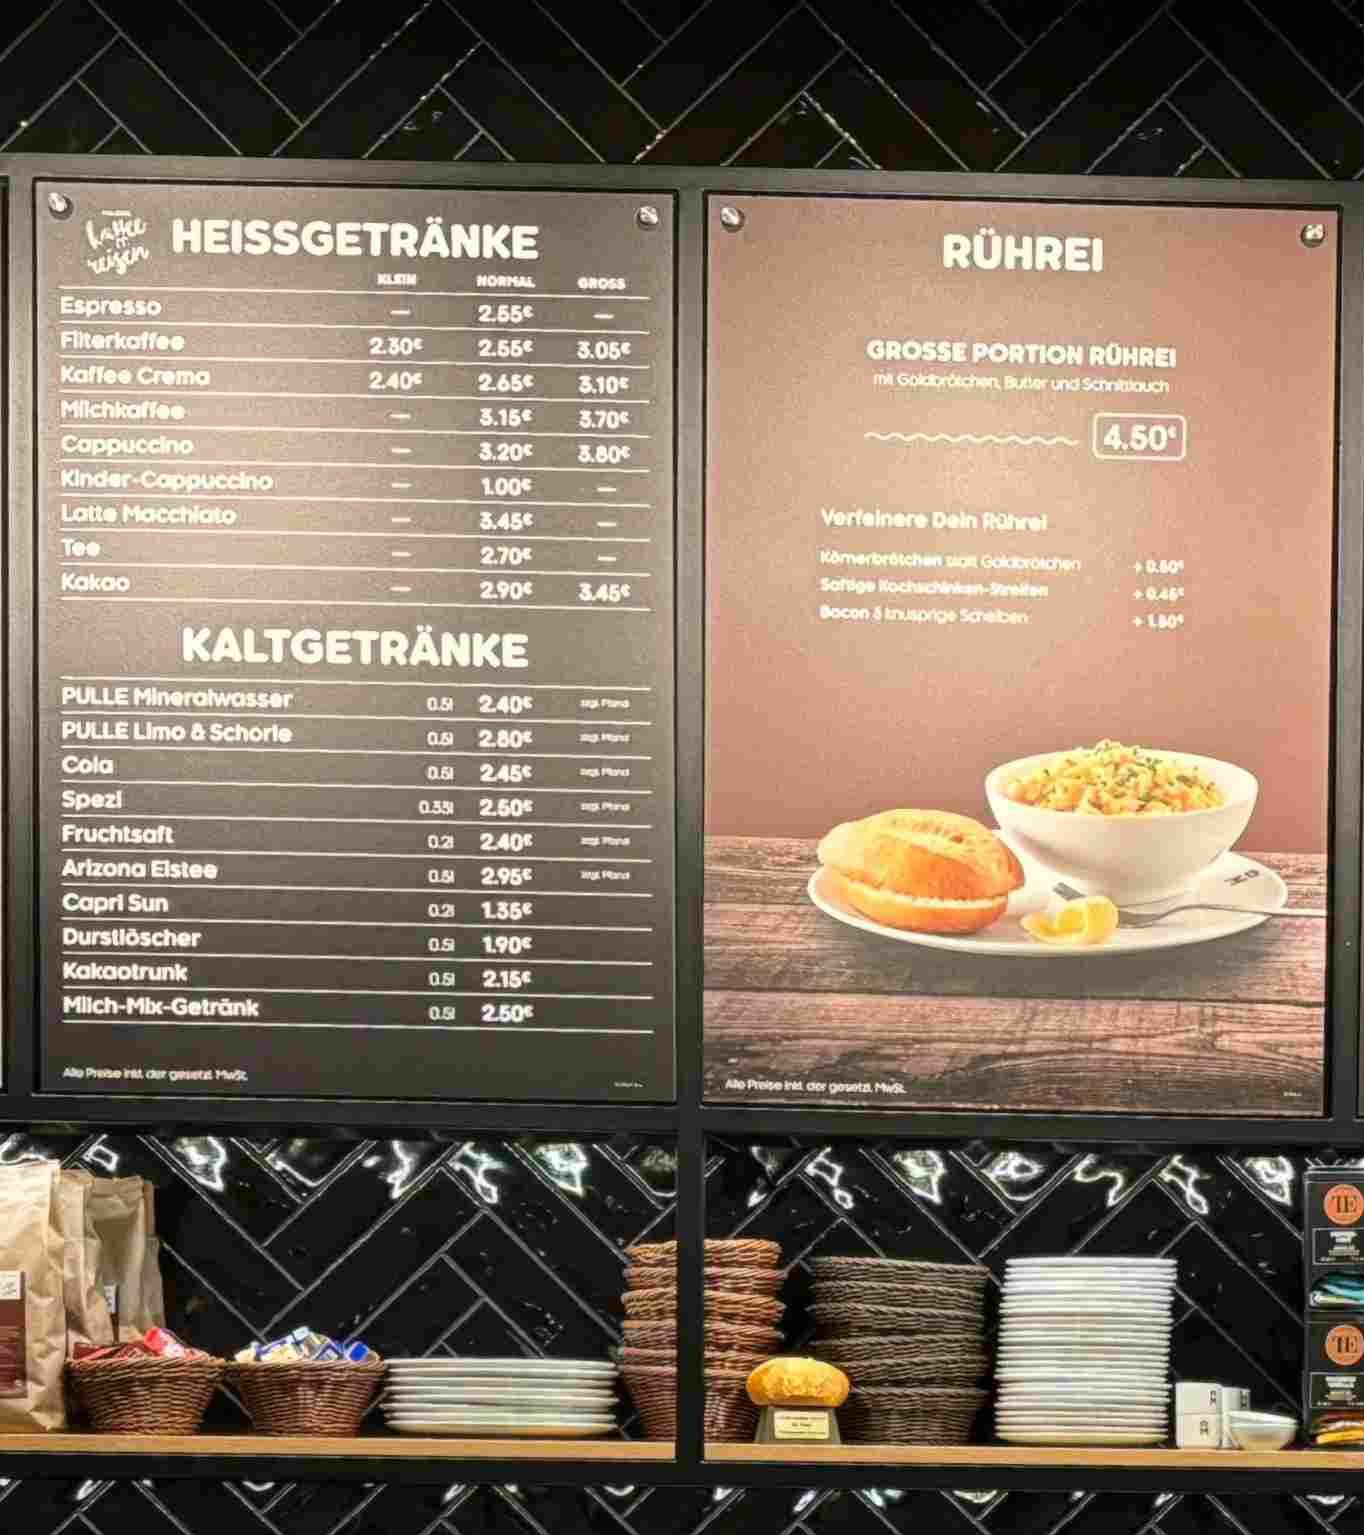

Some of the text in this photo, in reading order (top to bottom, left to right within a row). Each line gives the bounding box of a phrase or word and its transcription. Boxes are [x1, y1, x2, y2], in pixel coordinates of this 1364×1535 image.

[172, 218, 539, 260] HEISSGETRÄNKE
[942, 227, 1105, 273] RÜHREI
[377, 273, 416, 285] KLEIN
[476, 276, 536, 288] NORMAL
[577, 278, 626, 290] GROSS
[60, 295, 161, 318] Espresso
[60, 330, 185, 352] Filterkaffee
[866, 339, 1177, 369] GROSSE PORTION RÜHREI
[60, 365, 210, 387] Kaffee Crema
[60, 400, 186, 421] Milchkaffee
[60, 434, 194, 456] Cappuccino
[60, 469, 272, 493] Kinder-Cappuccino
[60, 504, 236, 526] Latte Macchiato
[820, 509, 1047, 533] Verfeinere Dein Rührei
[60, 539, 100, 557] Tee
[60, 573, 130, 592] Kakao
[182, 625, 529, 669] KALTGETRÄNKE
[61, 686, 293, 708] PULLE Mineralwasser
[61, 721, 129, 741] PULLE
[133, 722, 187, 742] Limo
[210, 724, 292, 743] Schorle
[61, 755, 114, 775] Cola
[61, 789, 121, 811] Spezi
[61, 824, 174, 845] Fruchtsaft
[61, 859, 218, 880] Arizona Eistee
[62, 893, 168, 916] Capri Sun
[62, 927, 201, 948] Durstlöscher
[62, 961, 188, 983] Kakaotrunk
[62, 996, 259, 1018] Milch-Mix-Getränk
